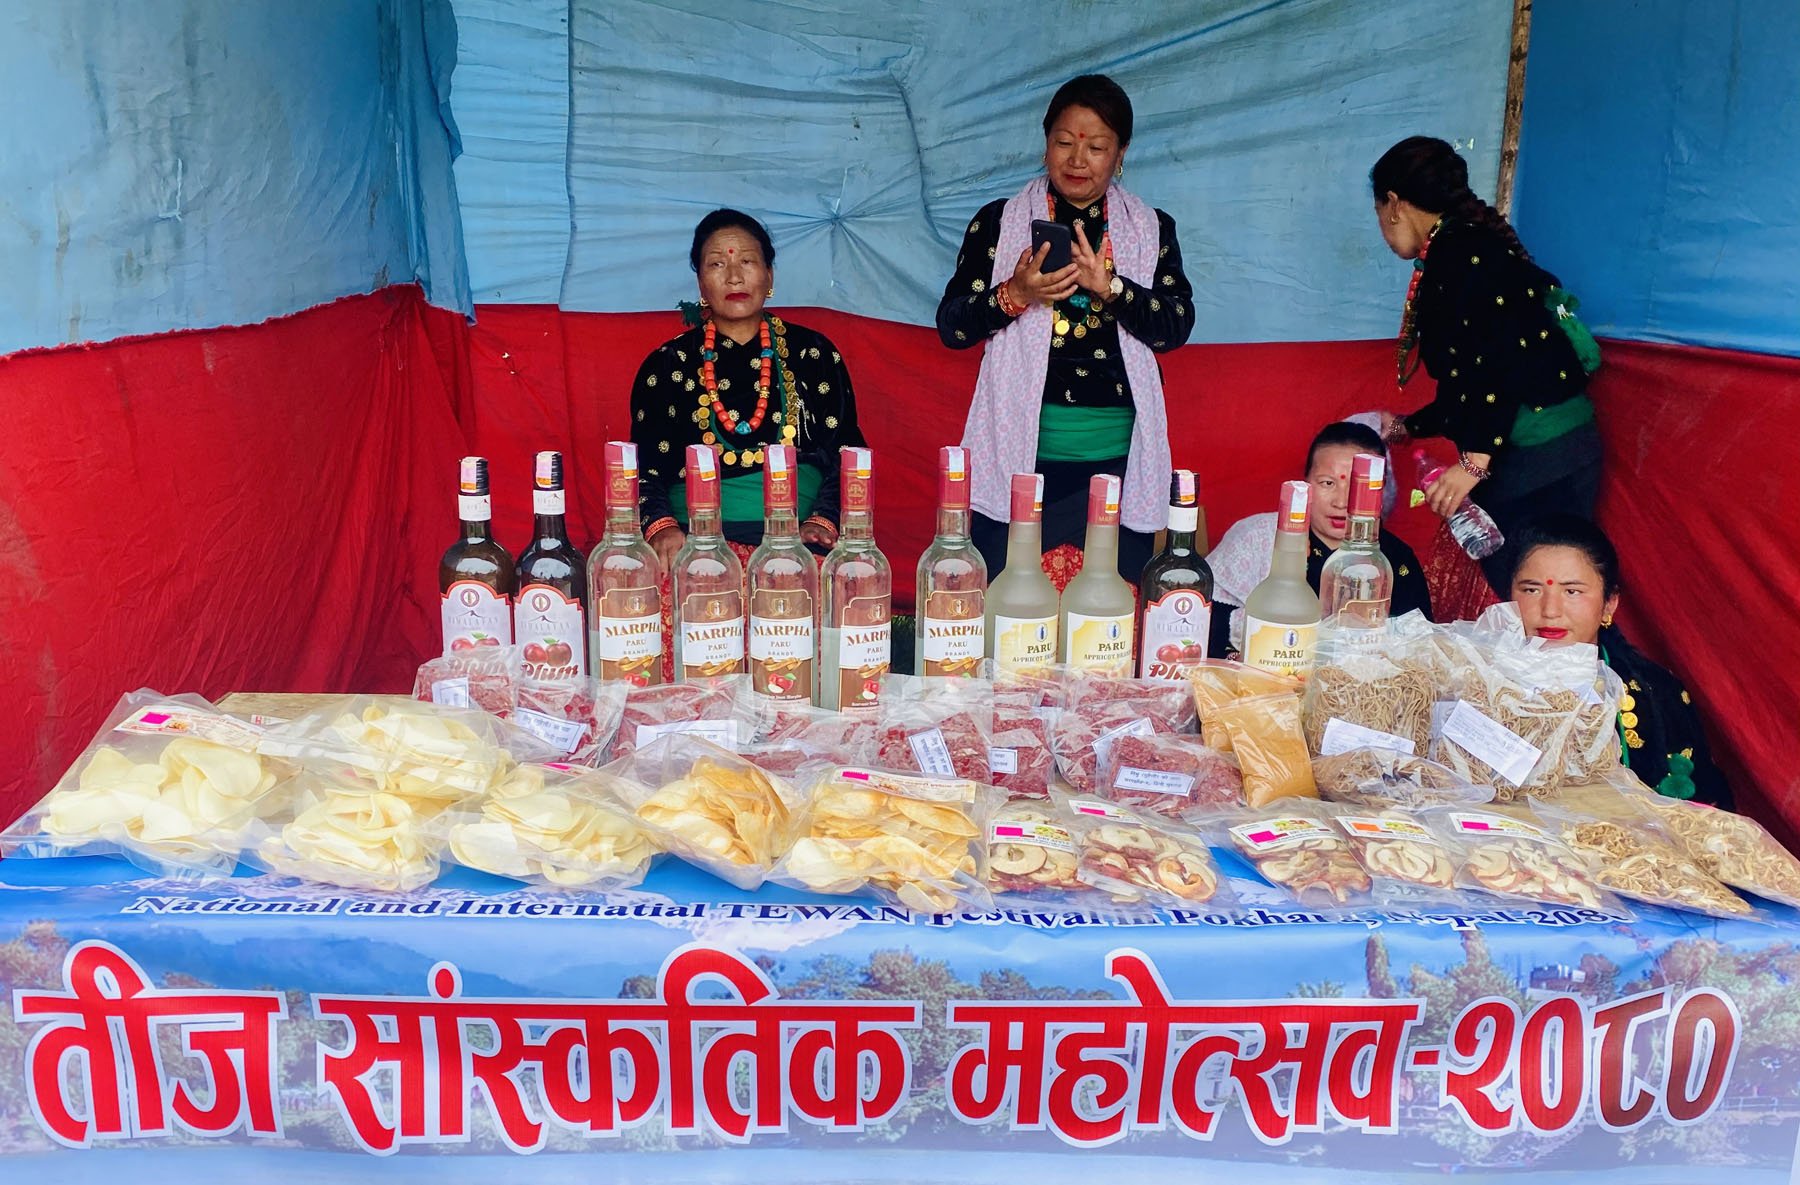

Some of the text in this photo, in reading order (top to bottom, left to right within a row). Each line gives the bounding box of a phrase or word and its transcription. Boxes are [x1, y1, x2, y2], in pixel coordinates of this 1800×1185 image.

[605, 622, 660, 639] MARPHA
[686, 626, 742, 643] MARPHA
[753, 625, 810, 637] MARPHA
[928, 625, 982, 638] MARPHA
[708, 643, 728, 651] PARU
[1027, 642, 1052, 654] PARU
[1098, 641, 1126, 652] PARU
[1273, 649, 1304, 658] PARU
[521, 662, 578, 681] Plum
[130, 897, 341, 914] National
[348, 900, 442, 915] and
[451, 899, 703, 918] Internatial
[720, 904, 912, 923] TEWAN
[21, 946, 281, 1143] तीज
[318, 947, 916, 1149] सांस्कतिक
